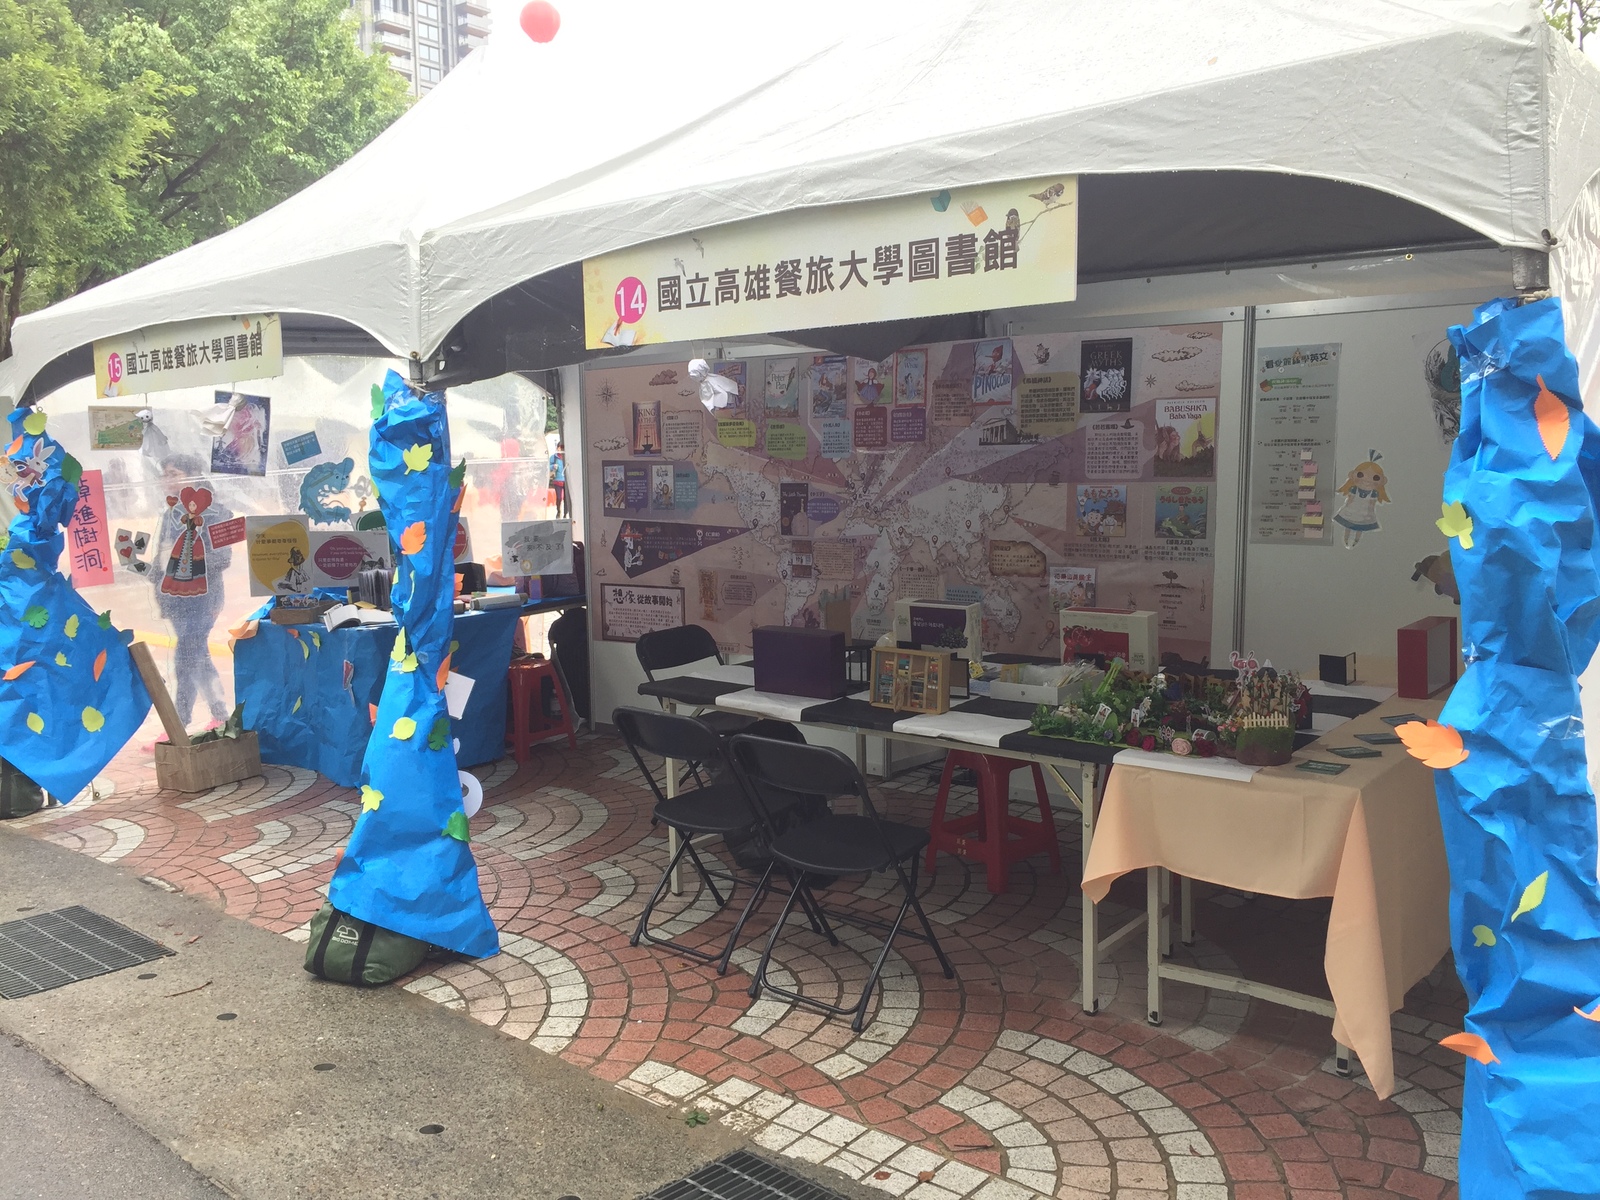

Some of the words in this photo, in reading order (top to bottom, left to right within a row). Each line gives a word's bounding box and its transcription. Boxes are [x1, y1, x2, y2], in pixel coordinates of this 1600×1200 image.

[657, 229, 1018, 313] 國立高雄餐旅大學圖書館
[615, 284, 645, 317] 14
[126, 331, 263, 376] 國立高雄餐旅大學圖書館
[1090, 350, 1123, 359] GREEK
[1089, 358, 1123, 367] MYTHS
[109, 361, 122, 378] 15
[771, 373, 786, 382] Peter
[776, 382, 788, 390] Pan
[974, 373, 1012, 398] PINOCCHIO
[638, 408, 656, 417] KING
[1164, 404, 1208, 413] BABUSHKA
[1083, 488, 1120, 499] ももたろう
